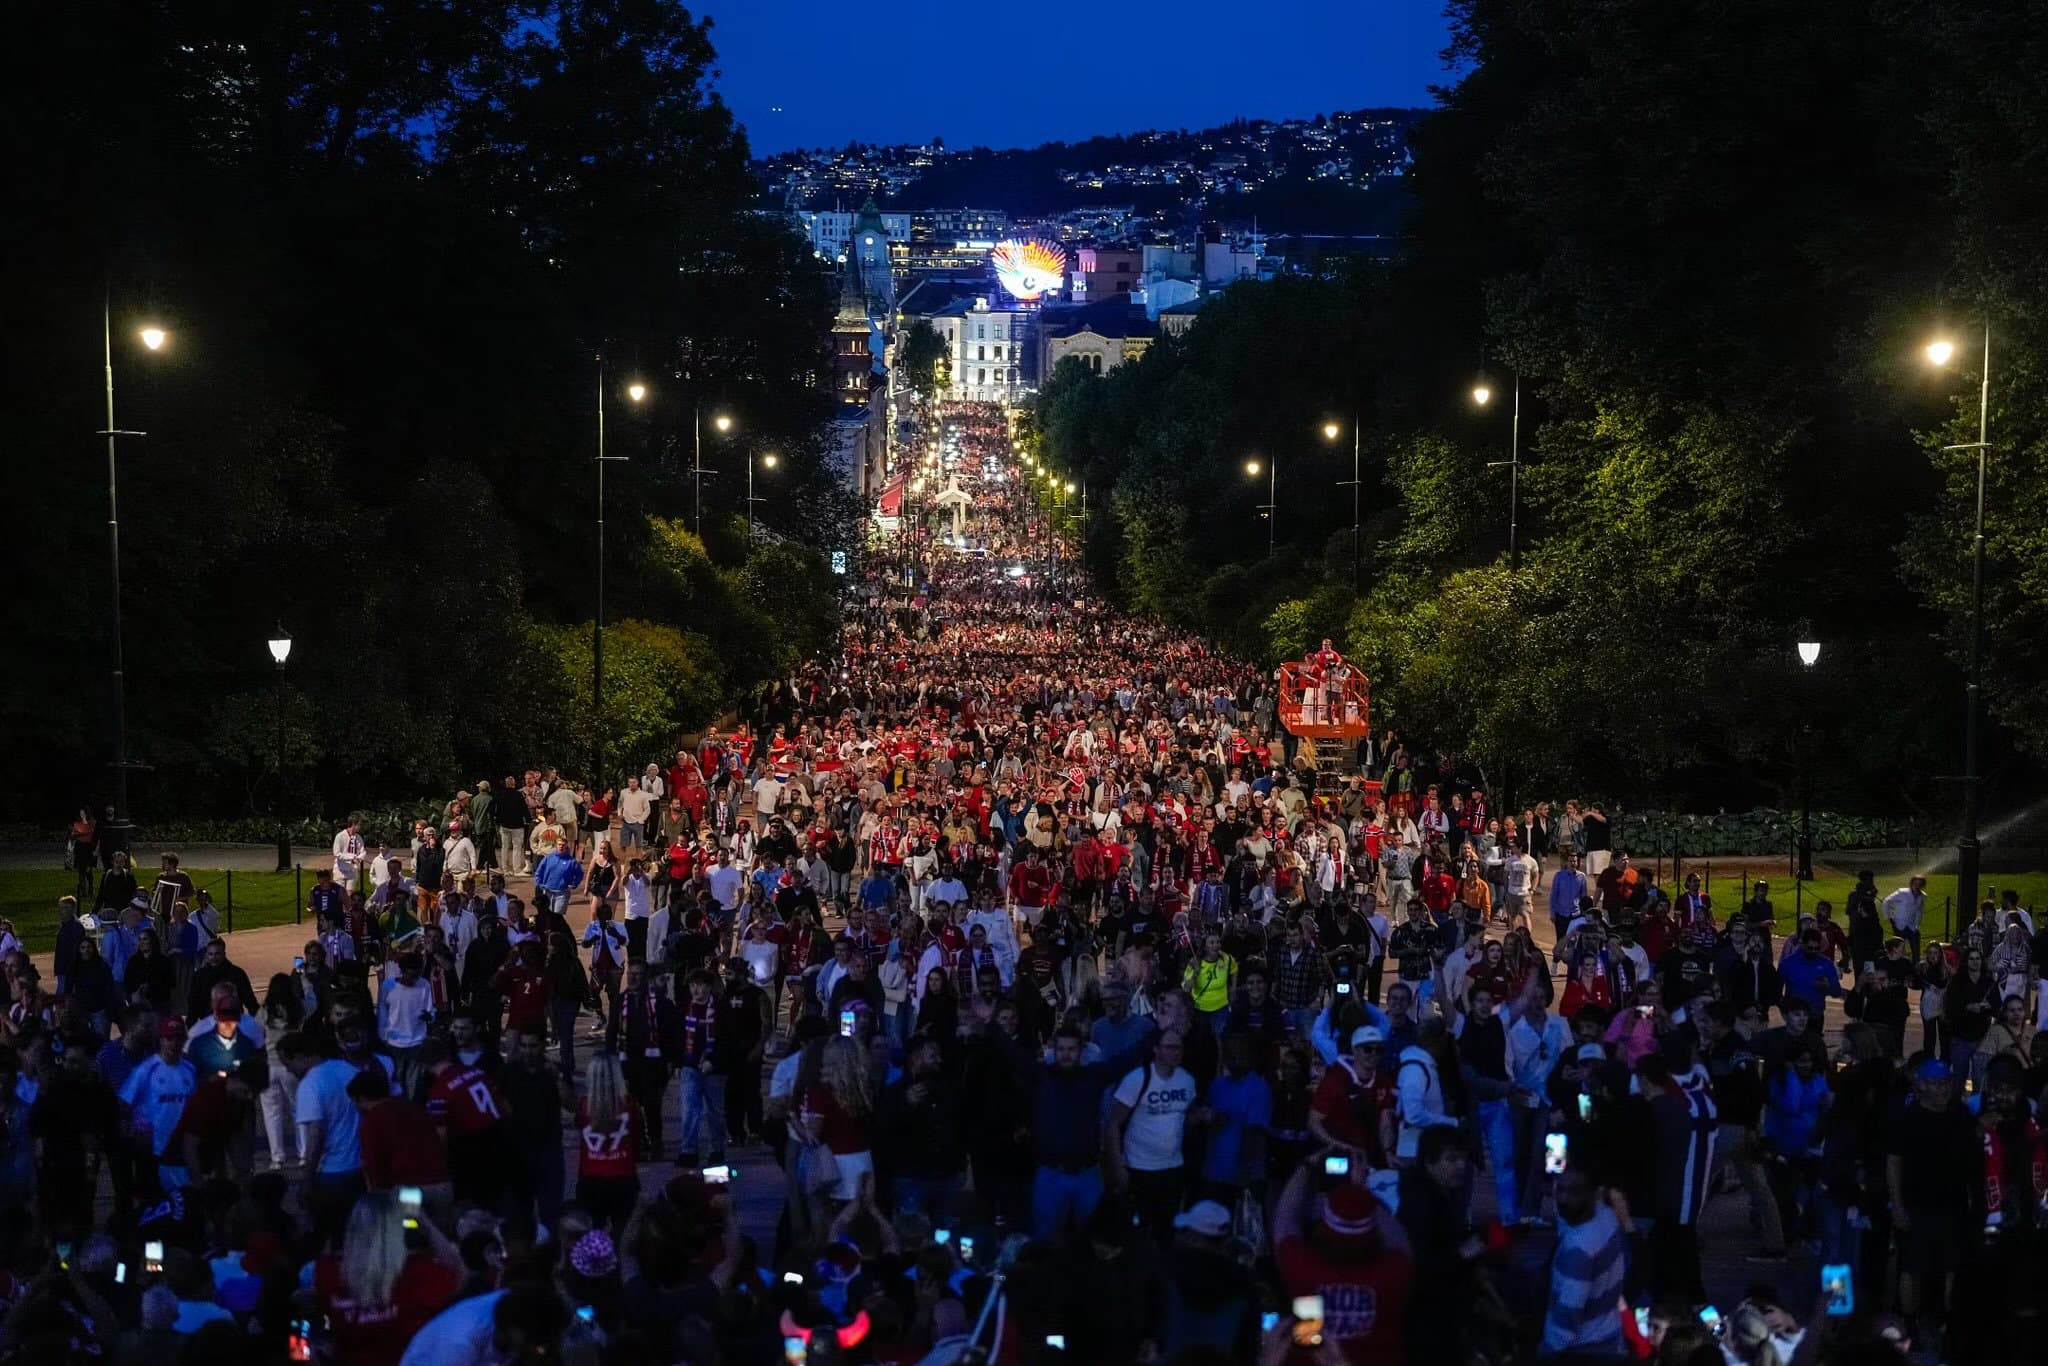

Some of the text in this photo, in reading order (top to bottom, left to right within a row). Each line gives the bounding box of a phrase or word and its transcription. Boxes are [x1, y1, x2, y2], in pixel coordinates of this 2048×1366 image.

[522, 981, 531, 995] 2
[467, 1080, 502, 1119] 9
[1147, 1088, 1187, 1104] CORE
[582, 1111, 630, 1152] 67
